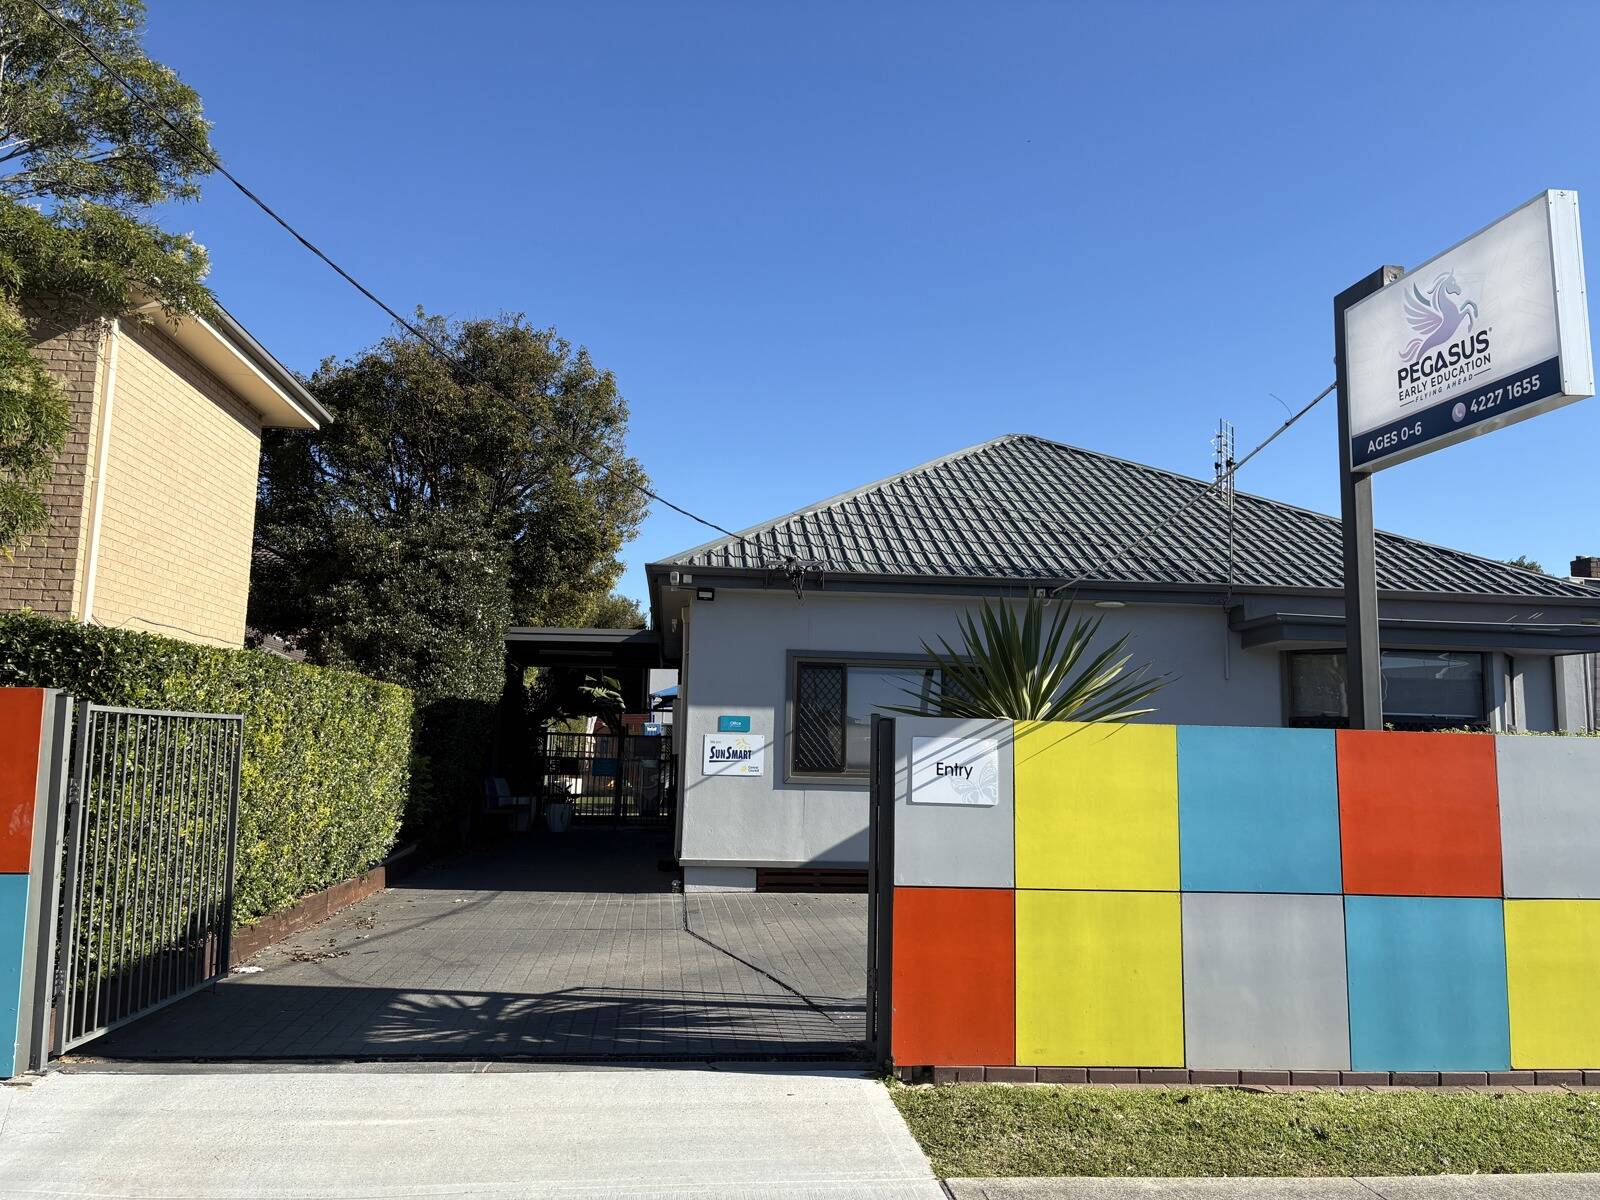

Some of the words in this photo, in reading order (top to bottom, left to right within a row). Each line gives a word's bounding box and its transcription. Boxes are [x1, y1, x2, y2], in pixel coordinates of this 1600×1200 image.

[1398, 330, 1489, 389] PEGASUS
[1399, 381, 1427, 401] EARLY
[1431, 353, 1491, 387] EDUCATION
[1416, 387, 1442, 402] FLYING
[1447, 374, 1473, 390] AHEAD
[1470, 389, 1503, 413] 4227
[1507, 374, 1540, 399] 1655
[1367, 431, 1397, 453] AGES
[1401, 421, 1422, 440] 0-6
[936, 762, 973, 779] Entry
